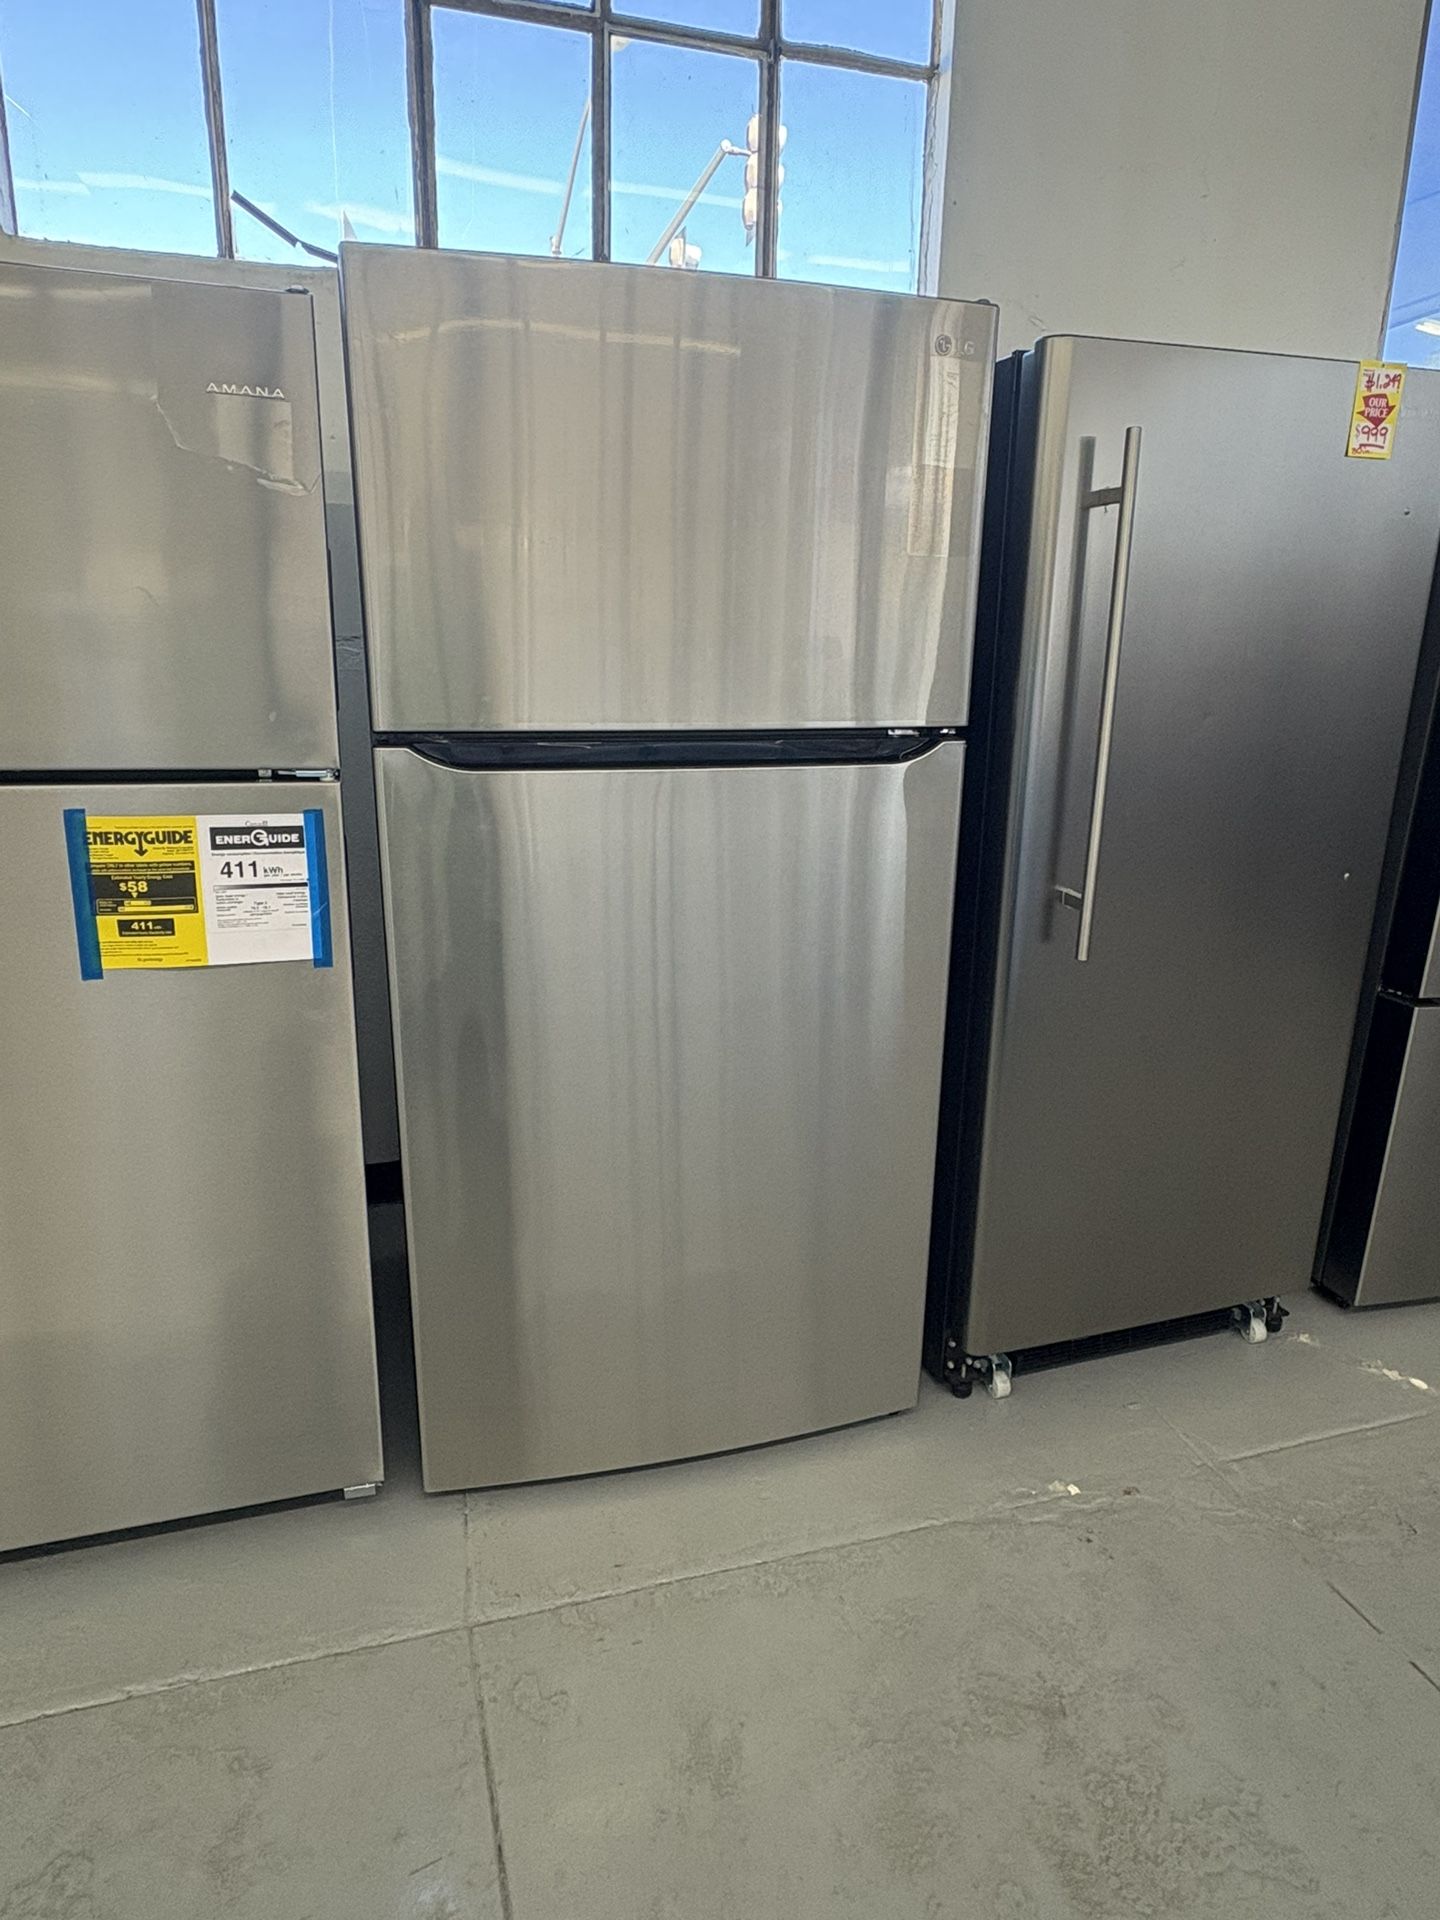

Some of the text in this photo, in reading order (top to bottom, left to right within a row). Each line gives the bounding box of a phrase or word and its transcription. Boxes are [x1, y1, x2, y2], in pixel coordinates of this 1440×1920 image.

[206, 382, 285, 399] AMANA
[1369, 397, 1388, 408] OUR
[1364, 407, 1389, 418] PRICE
[1356, 425, 1388, 445] $999
[87, 829, 193, 847] ENERGYGUIDE
[215, 829, 300, 847] ENERGUIDE
[220, 860, 284, 879] 411 kWh
[119, 881, 148, 892] $58
[131, 921, 153, 930] 411
